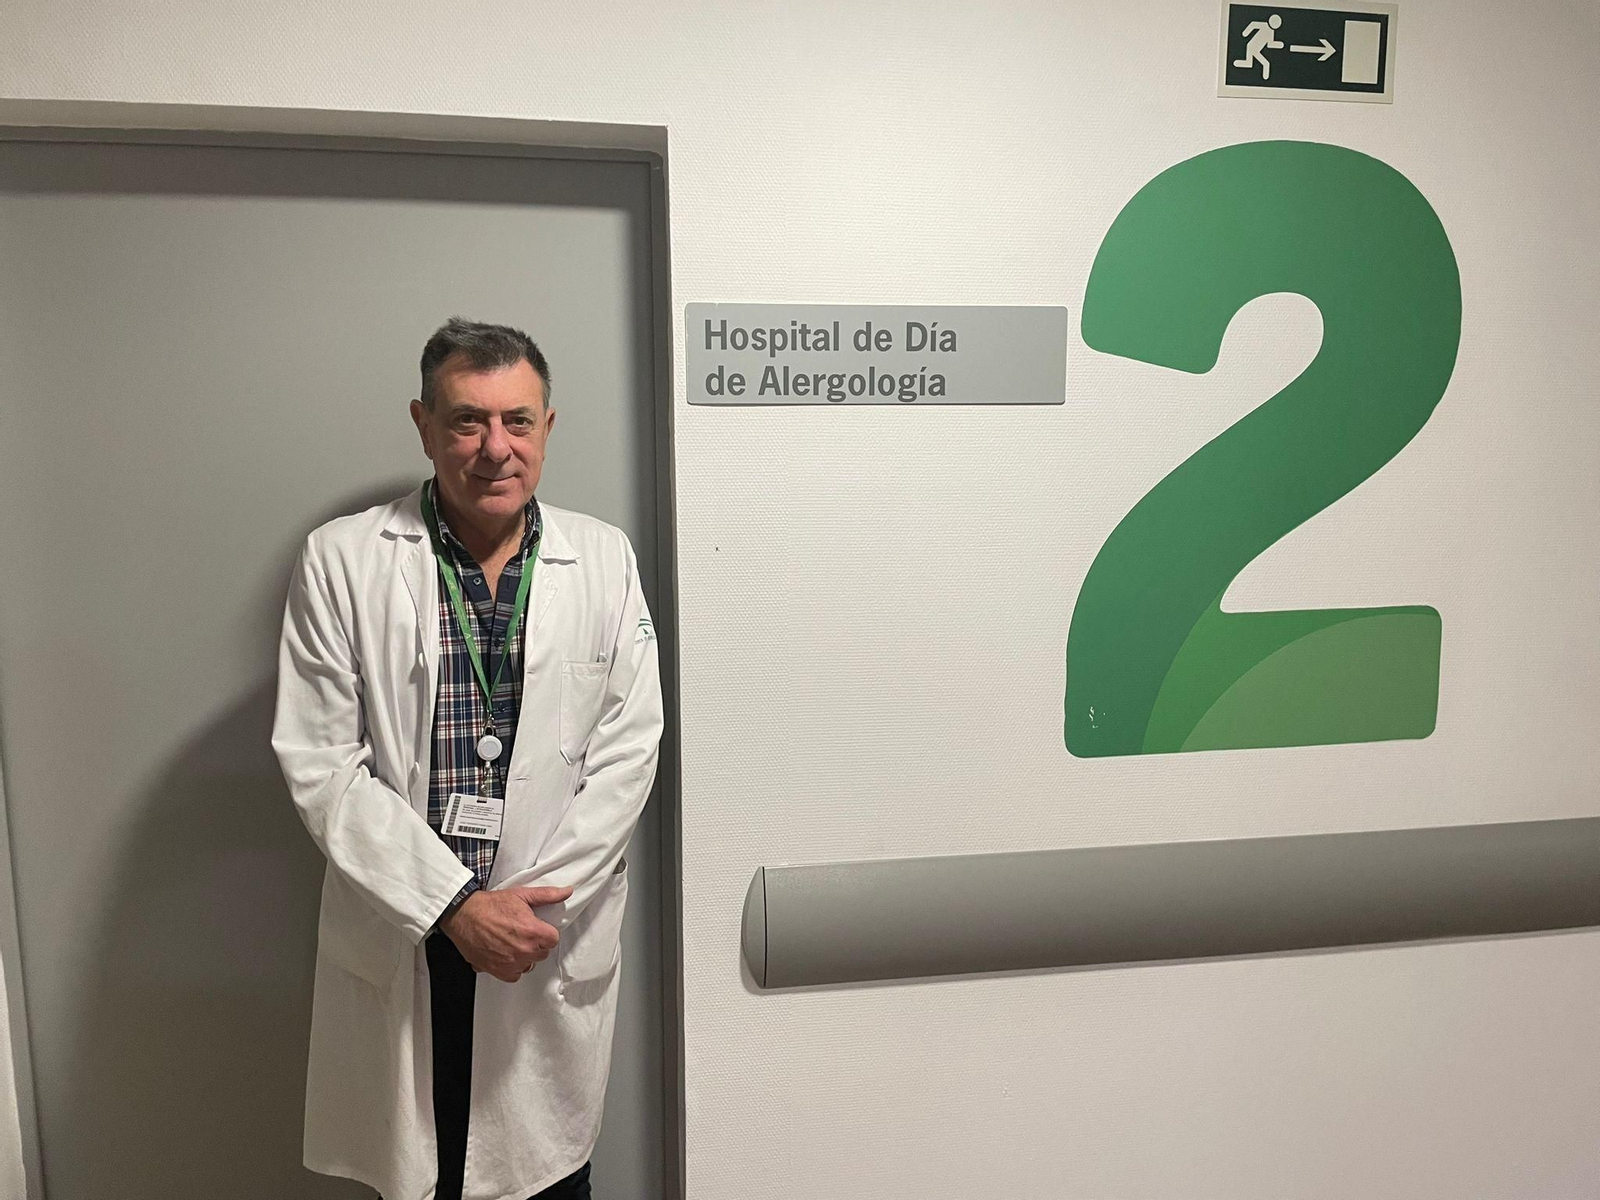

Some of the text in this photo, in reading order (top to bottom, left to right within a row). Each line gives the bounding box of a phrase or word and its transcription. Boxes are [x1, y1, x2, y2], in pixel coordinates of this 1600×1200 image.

[704, 319, 957, 357] Hospital de Día
[705, 365, 946, 402] de Alergología
[1064, 140, 1462, 758] 2
